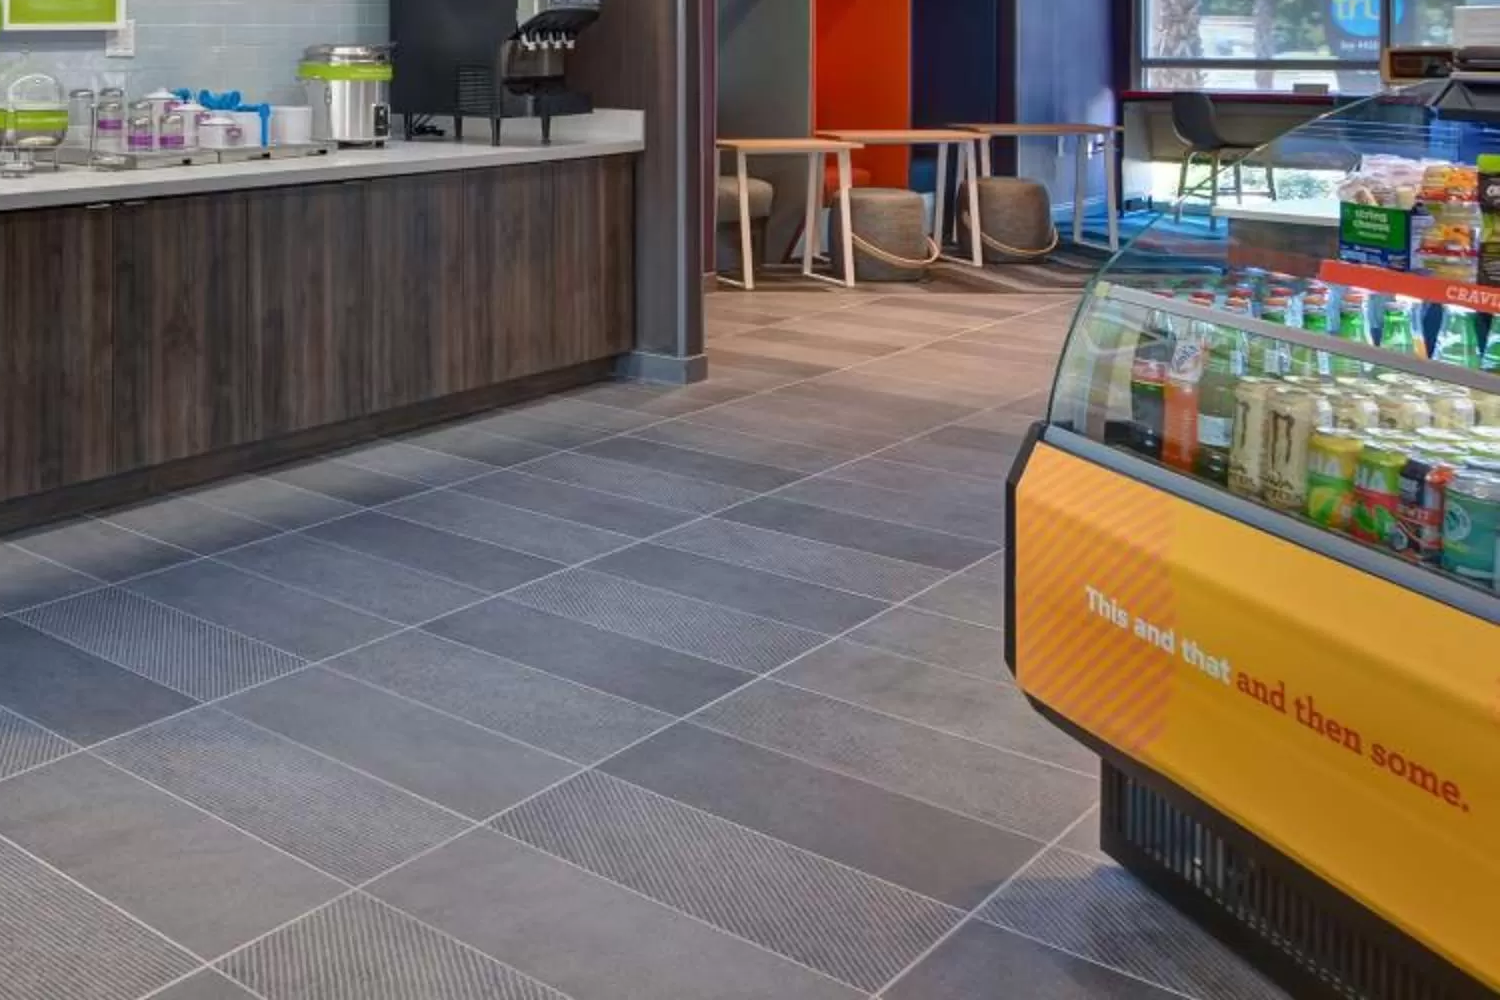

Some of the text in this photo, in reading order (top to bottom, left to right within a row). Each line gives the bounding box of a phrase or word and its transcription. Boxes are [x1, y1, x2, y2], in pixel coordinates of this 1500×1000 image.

[1446, 285, 1500, 313] CRAVI
[1085, 585, 1471, 814] This and that and then some.
